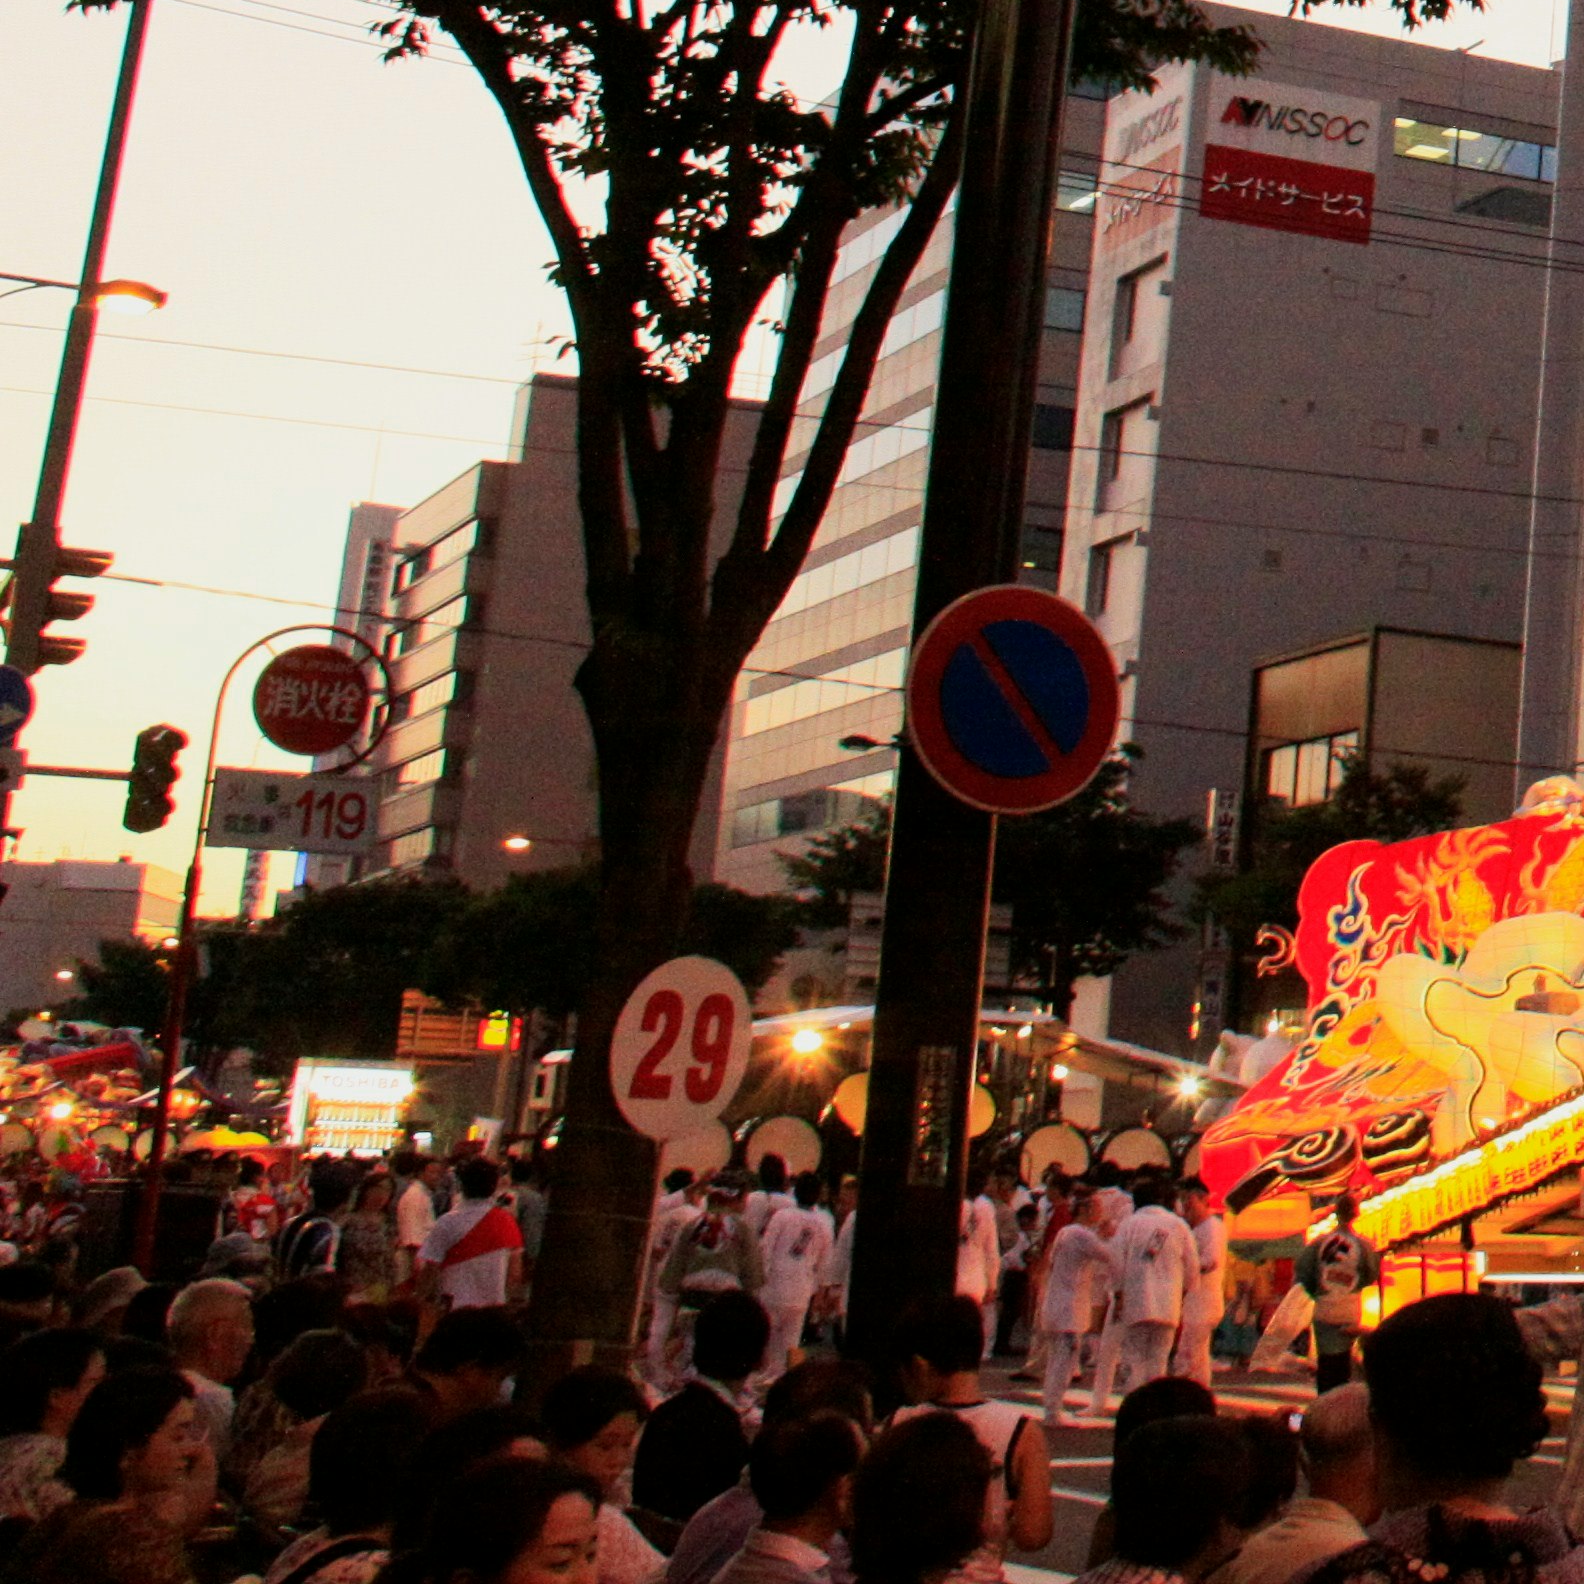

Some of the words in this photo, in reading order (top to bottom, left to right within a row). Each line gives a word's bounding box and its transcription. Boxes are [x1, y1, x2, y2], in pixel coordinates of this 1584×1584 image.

[1255, 102, 1369, 145] NISSOC
[264, 676, 360, 724] 消火栓
[296, 789, 367, 840] 119
[628, 989, 735, 1105] 29
[322, 1075, 399, 1089] TOSHIBA
